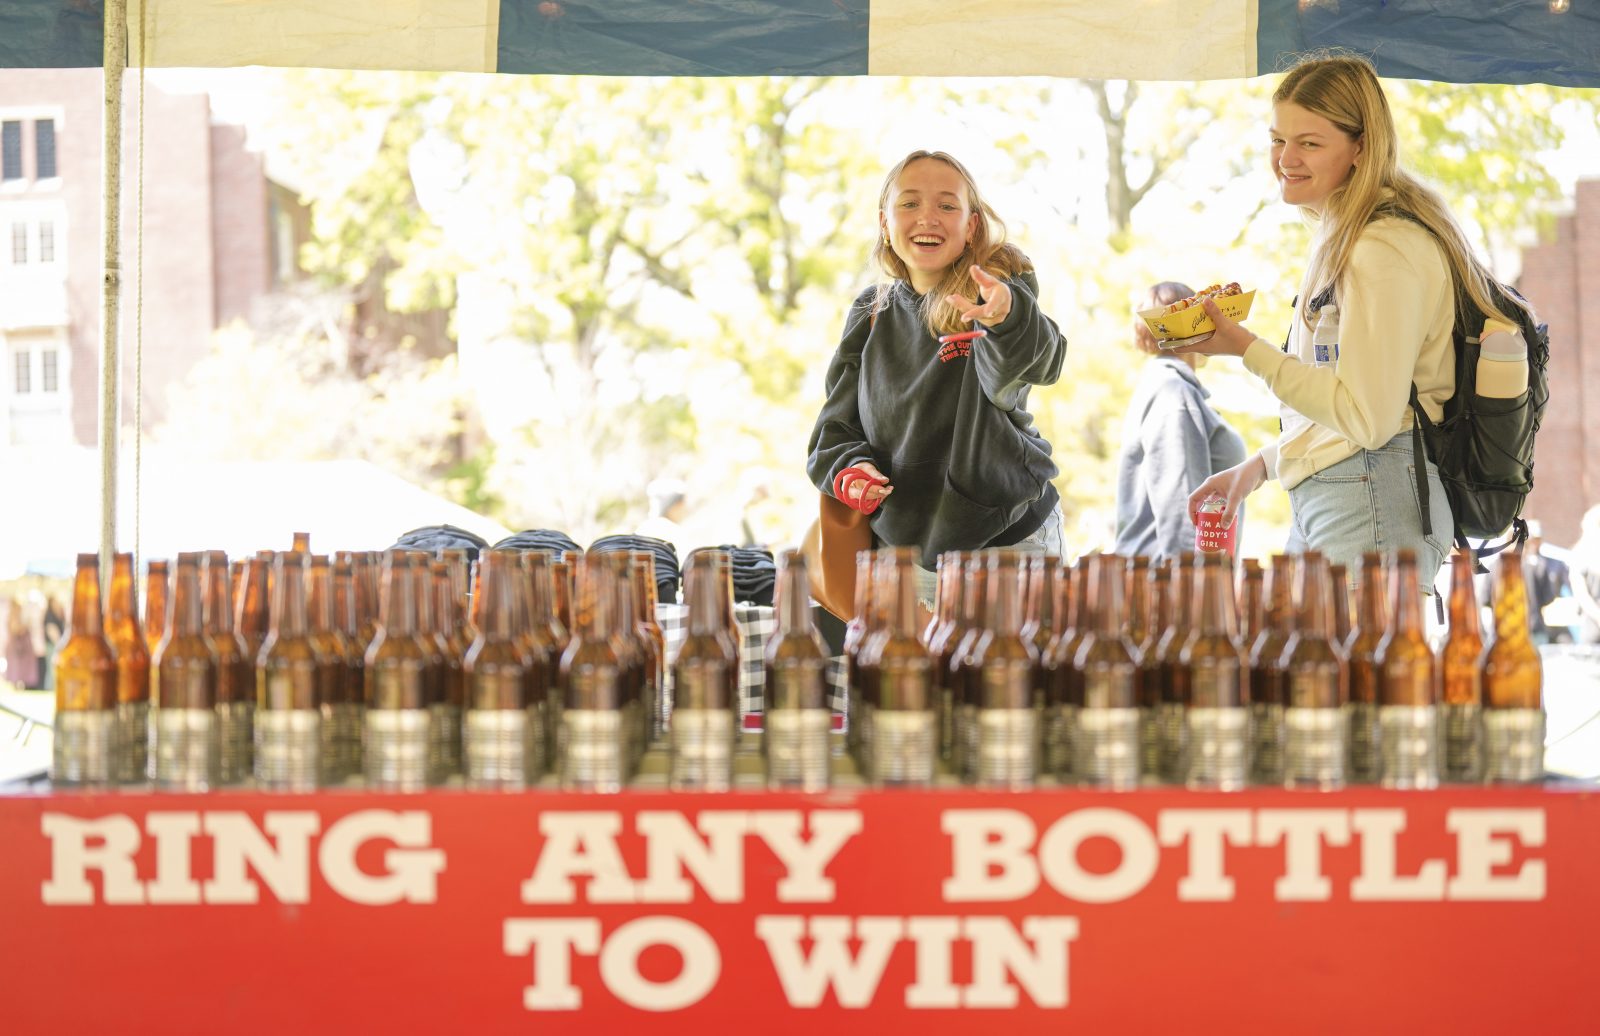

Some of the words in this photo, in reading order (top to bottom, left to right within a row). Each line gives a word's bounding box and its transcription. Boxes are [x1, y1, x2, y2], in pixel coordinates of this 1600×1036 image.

[939, 343, 956, 356] THE
[940, 350, 959, 363] TIME
[1200, 520, 1211, 528] I'M
[1200, 540, 1219, 548] GIRL
[40, 809, 447, 905] RING
[520, 809, 863, 904] ANY
[940, 807, 1547, 904] BOTTLE
[502, 915, 722, 1012] TO
[755, 915, 1080, 1010] WIN
